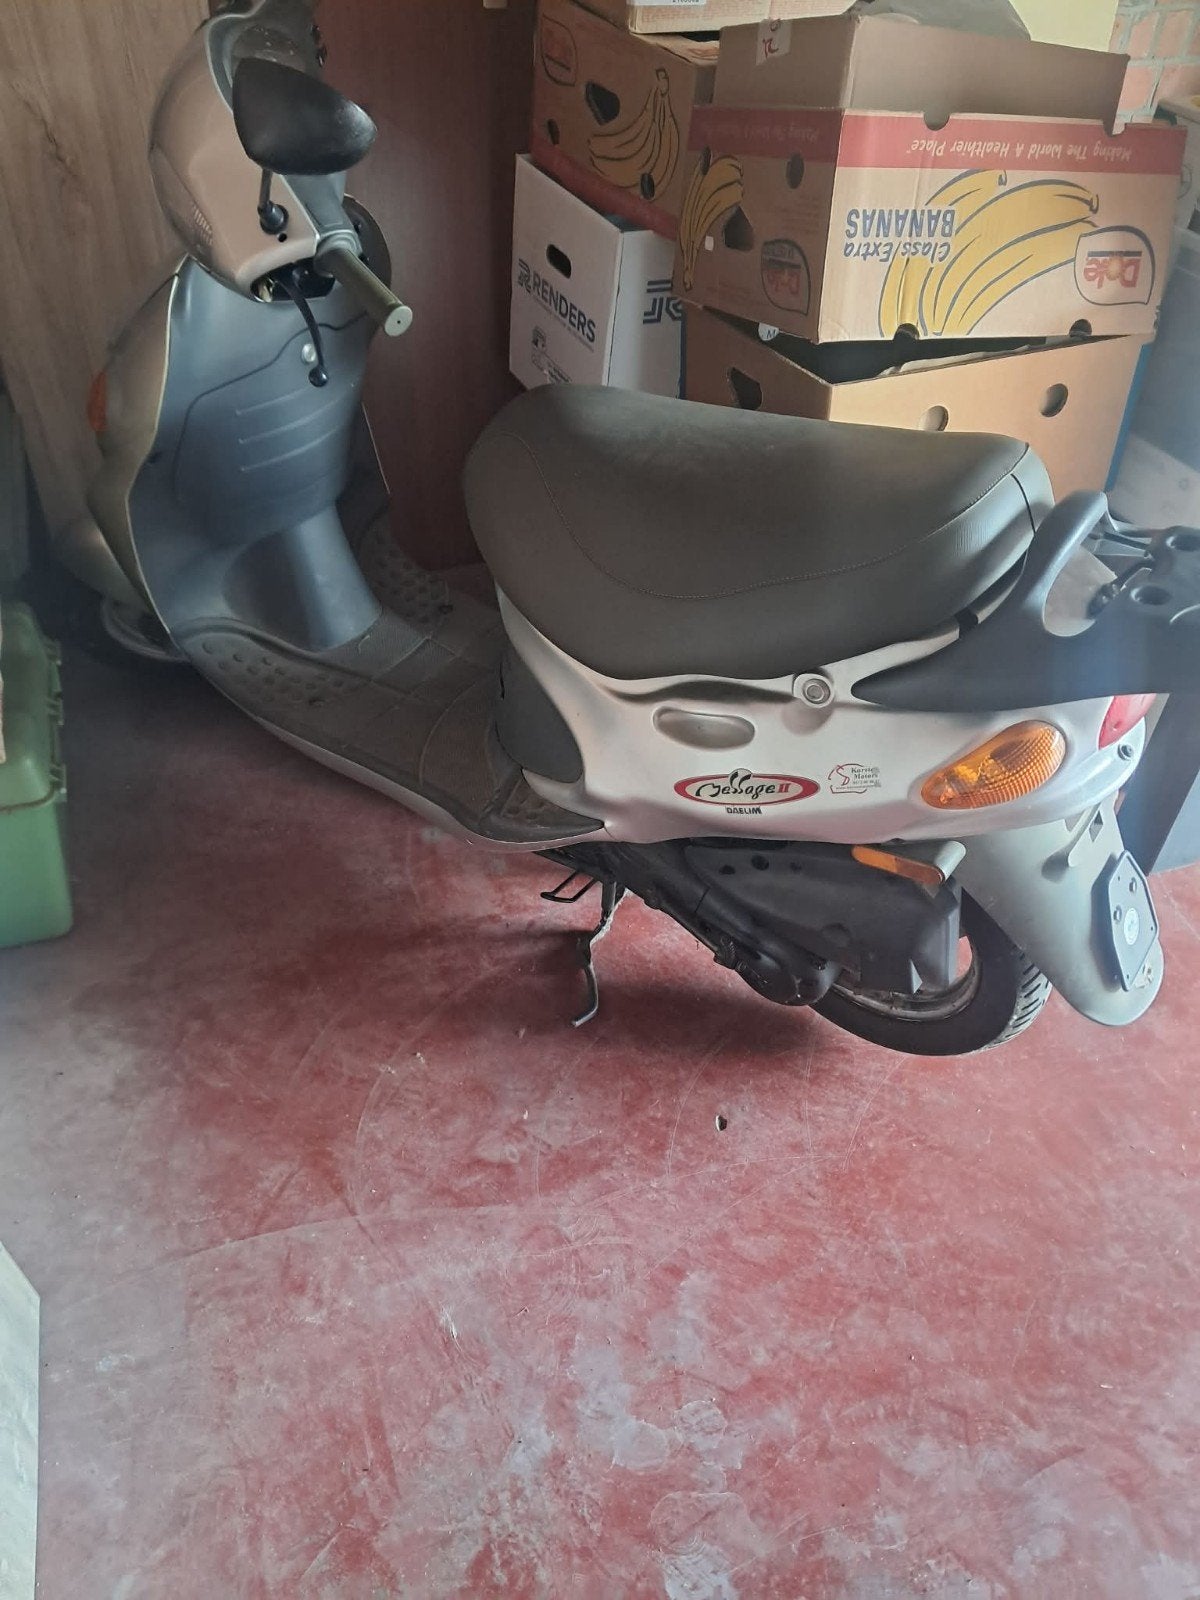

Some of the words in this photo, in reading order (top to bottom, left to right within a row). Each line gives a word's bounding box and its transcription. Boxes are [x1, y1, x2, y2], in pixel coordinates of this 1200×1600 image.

[950, 140, 1010, 157] Healthier
[1015, 143, 1024, 157] A
[1029, 143, 1062, 159] World
[1066, 144, 1087, 161] The
[1093, 140, 1133, 161] Making
[845, 209, 956, 239] BANANAS
[1084, 256, 1141, 289] Dole
[532, 270, 596, 343] RENDERS
[726, 806, 763, 815] DAELIM
